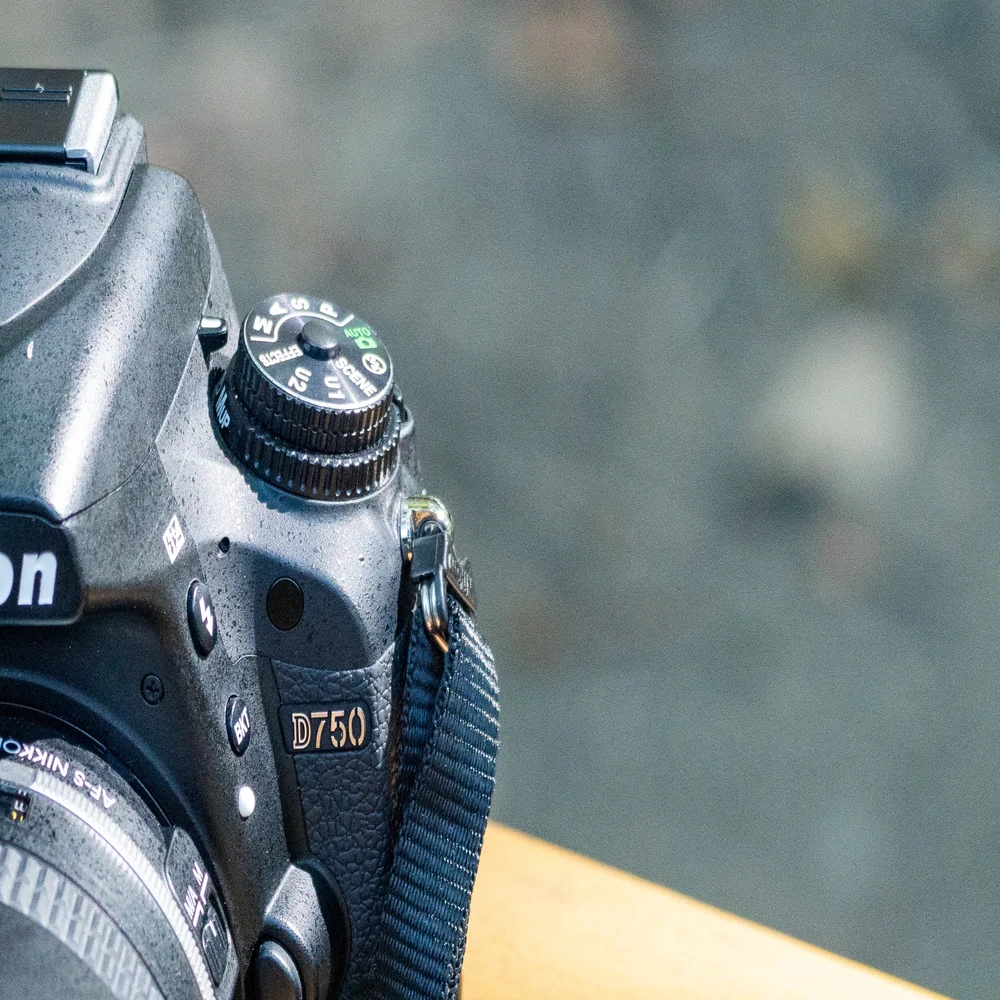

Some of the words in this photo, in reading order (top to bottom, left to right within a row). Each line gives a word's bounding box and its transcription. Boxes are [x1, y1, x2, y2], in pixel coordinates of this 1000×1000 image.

[269, 302, 289, 317] A
[290, 297, 310, 311] S
[319, 302, 338, 318] P
[253, 315, 274, 335] M
[344, 325, 371, 338] AUTO
[258, 344, 304, 367] EFFECTS
[288, 367, 313, 393] U2
[324, 375, 346, 400] U1
[335, 357, 378, 398] SCENE
[291, 706, 367, 750] D750
[73, 769, 118, 809] AF-S
